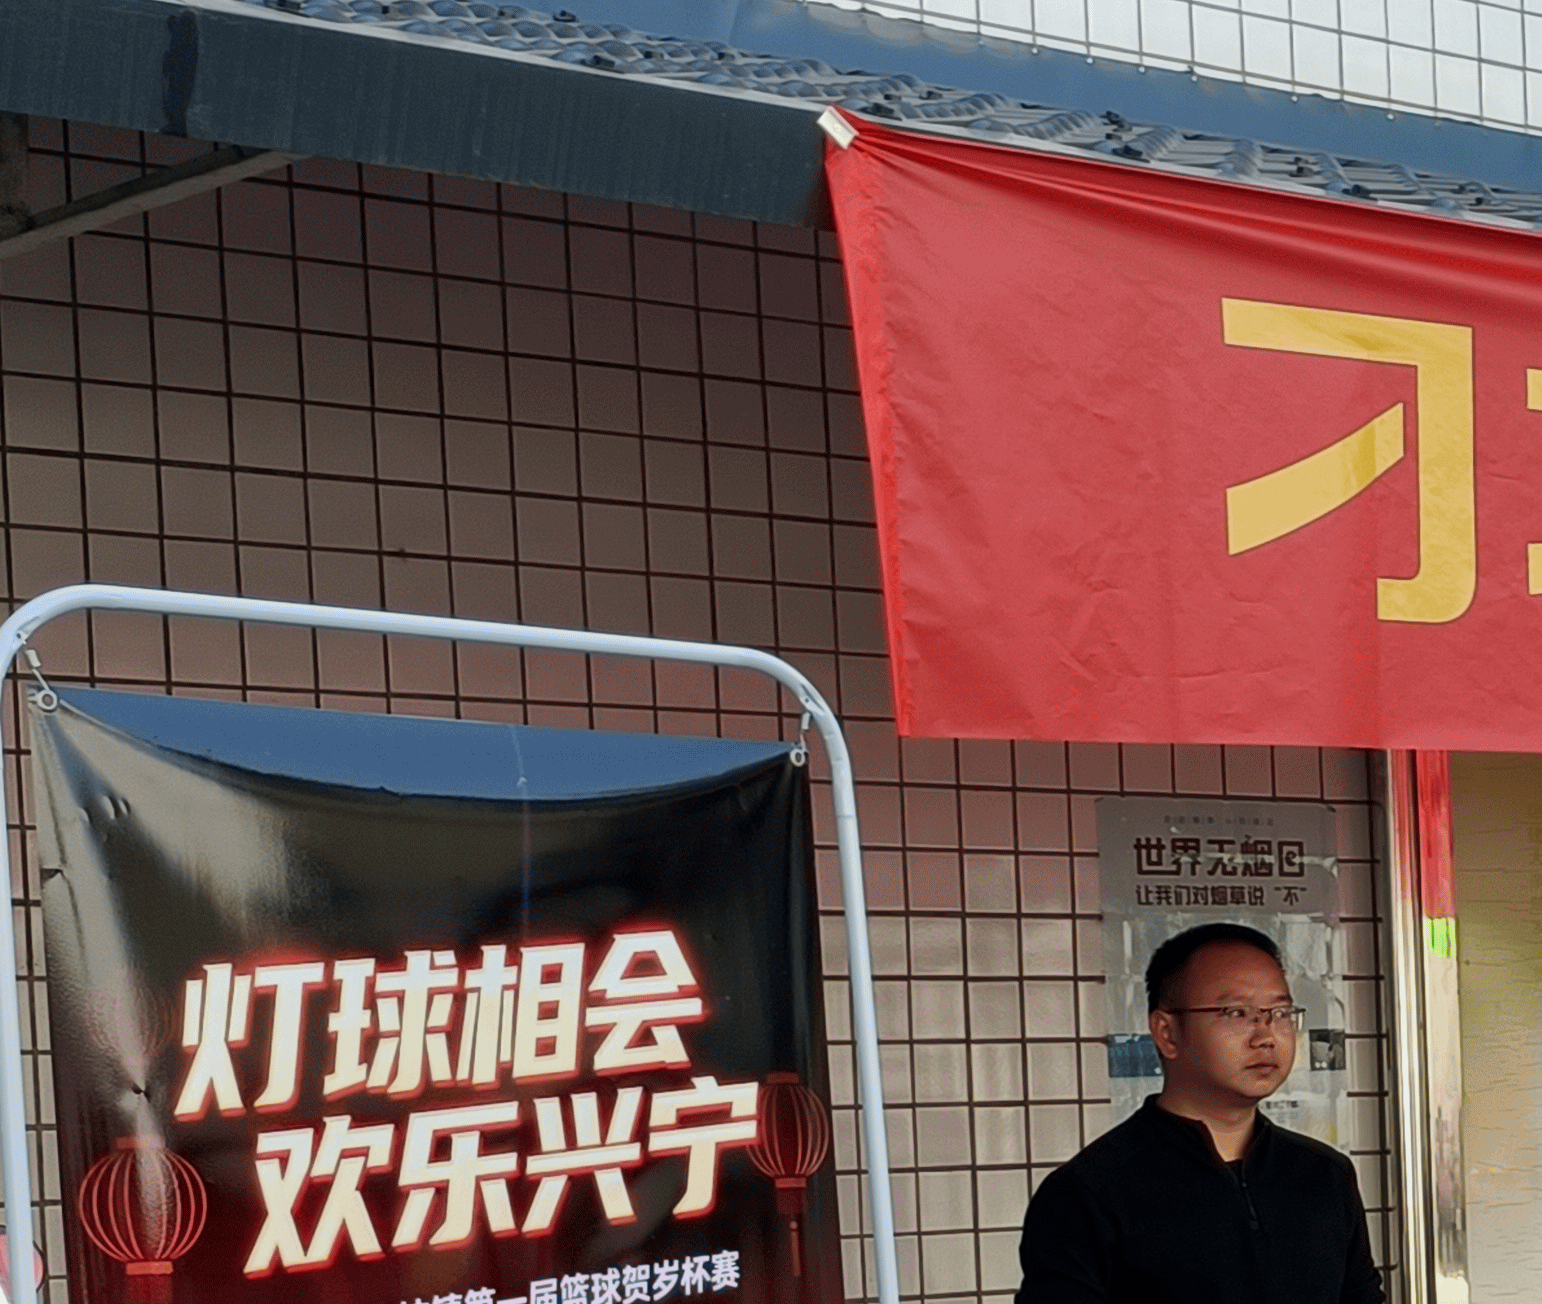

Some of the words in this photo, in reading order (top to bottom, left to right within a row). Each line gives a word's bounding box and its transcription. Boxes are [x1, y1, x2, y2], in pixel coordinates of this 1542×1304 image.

[174, 930, 704, 1120] 灯球相会
[243, 1076, 761, 1279] 欢乐兴宁
